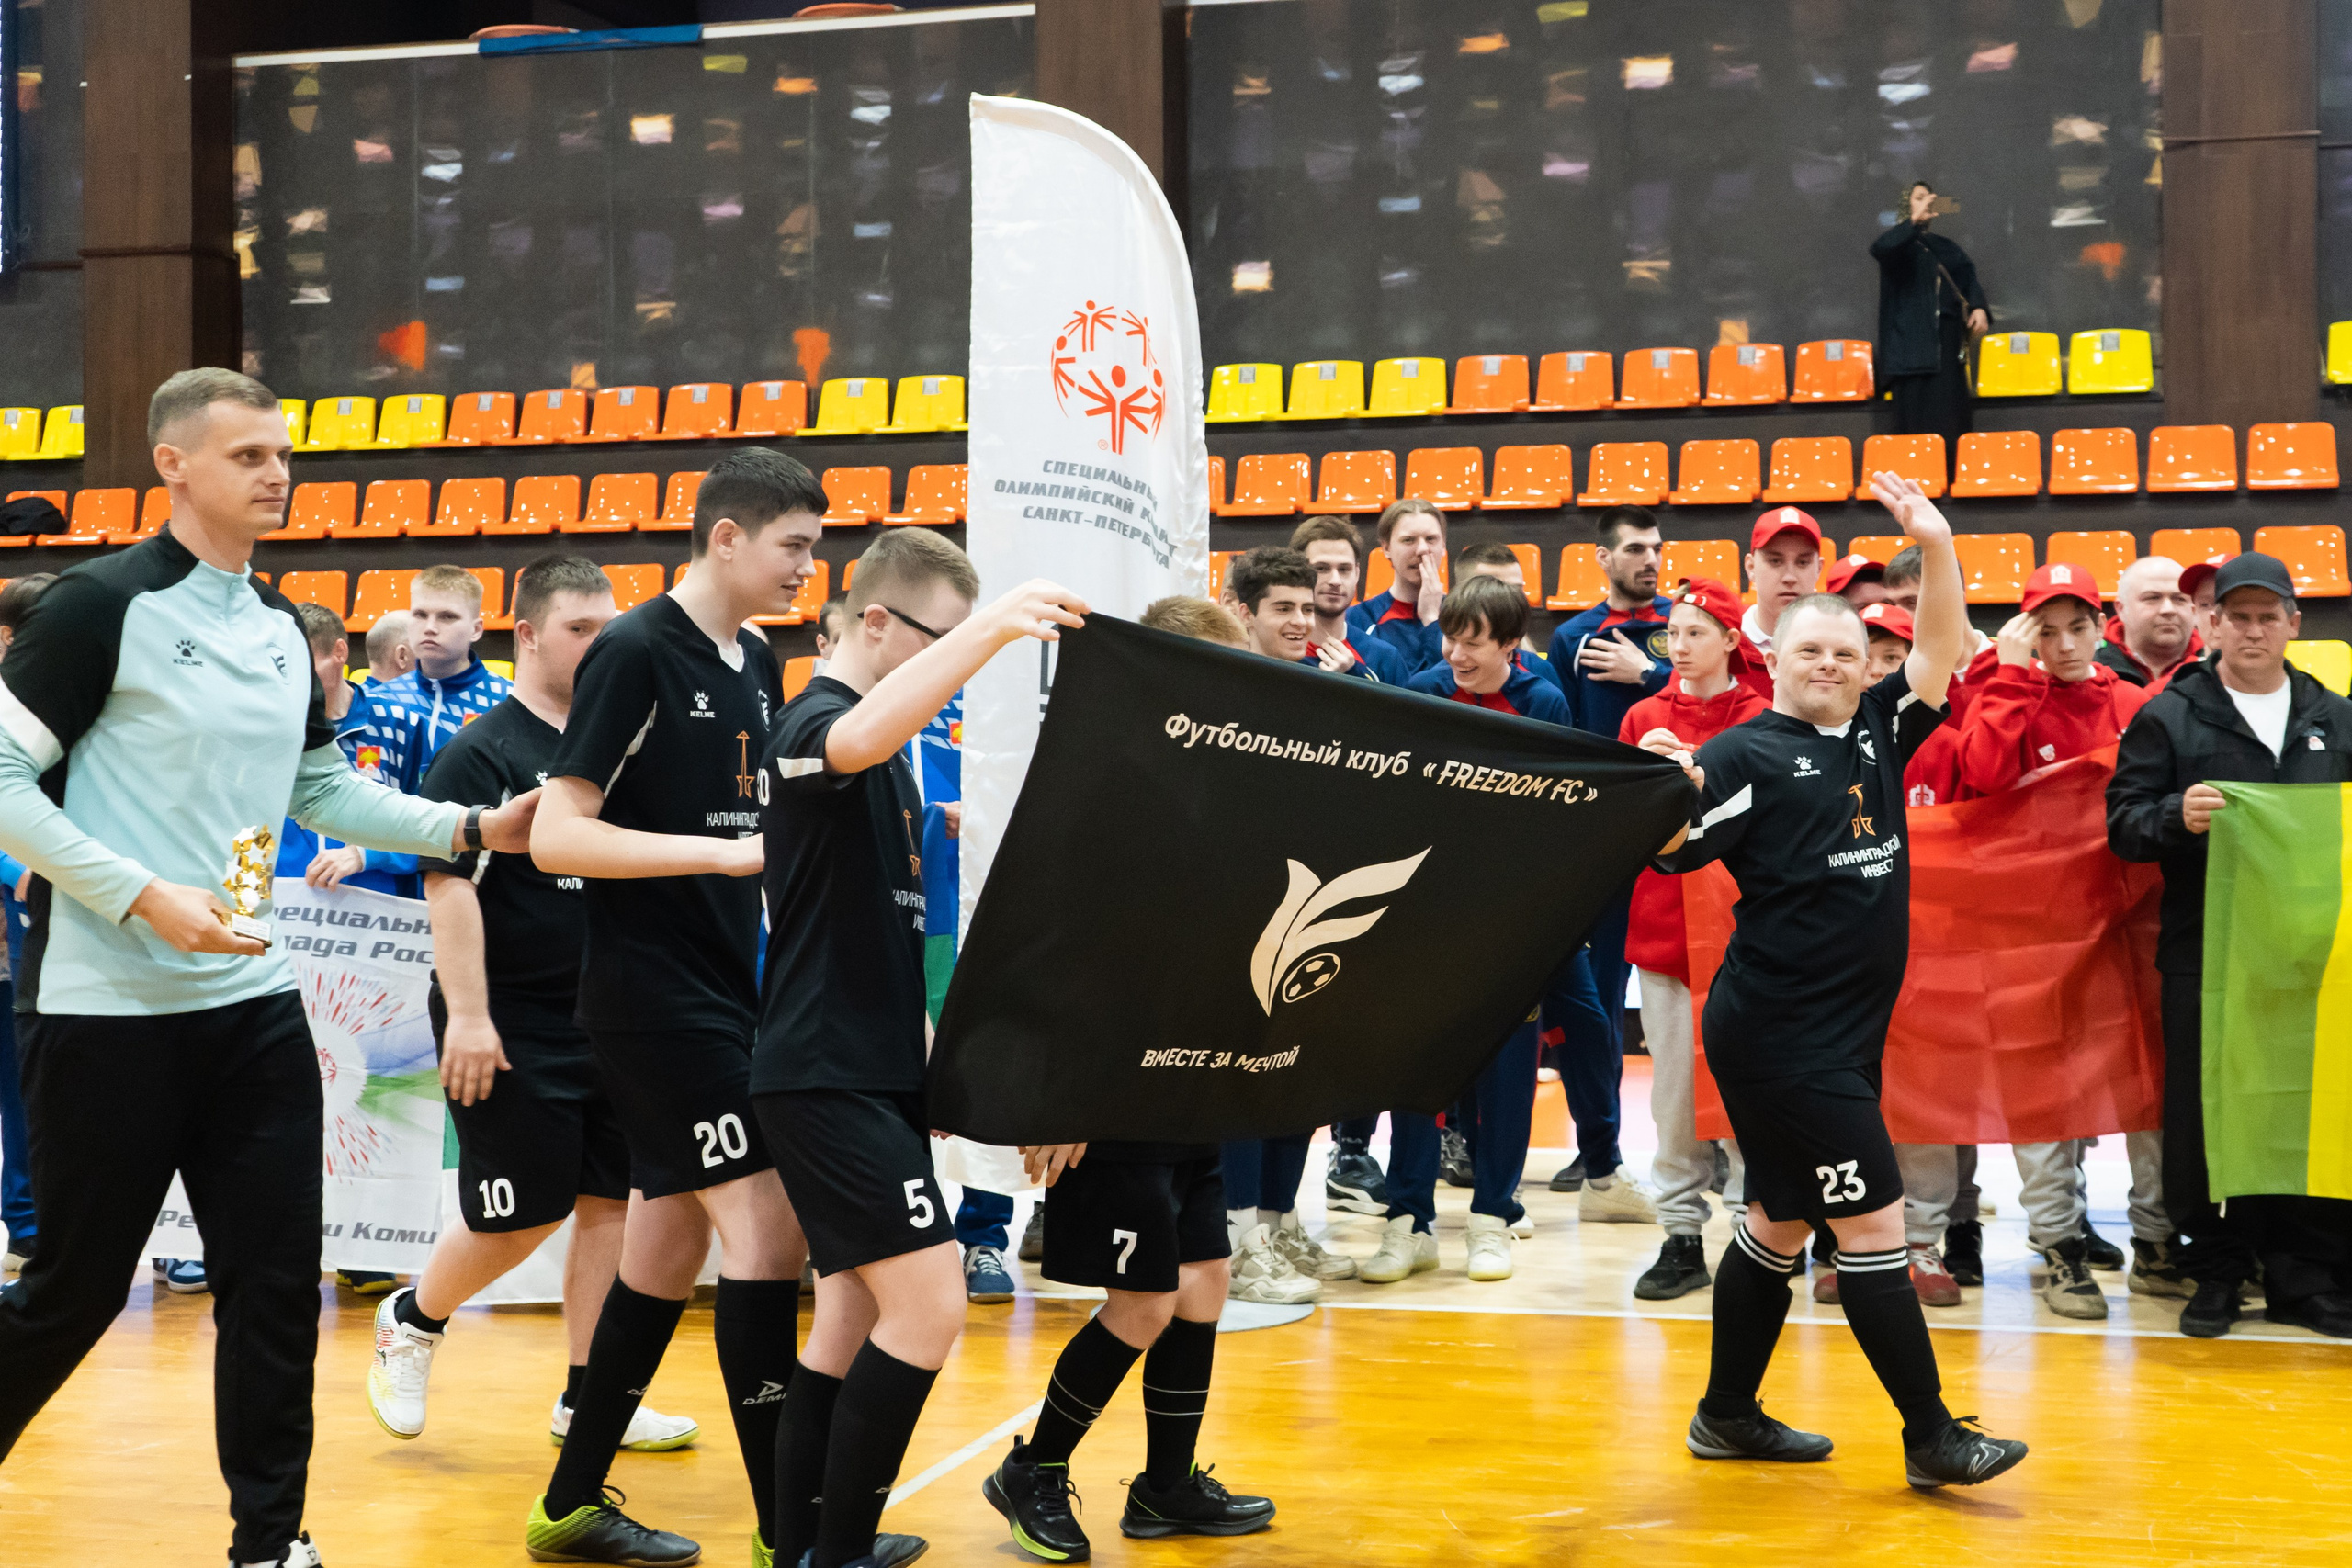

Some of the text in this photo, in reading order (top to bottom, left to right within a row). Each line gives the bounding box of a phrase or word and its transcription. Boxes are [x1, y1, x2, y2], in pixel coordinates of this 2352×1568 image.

[994, 479, 1135, 515] ОЛИМПИЙСКИЙ
[1165, 713, 1341, 766] Футбольный
[1345, 750, 1411, 779] клуб
[1793, 769, 1822, 777] KELME
[1141, 1045, 1300, 1073] ВМЕСТЕ ЗА МЕЧТОЙ
[694, 1113, 748, 1168] 20
[479, 1178, 515, 1219] 10
[903, 1178, 935, 1229] 5
[1816, 1159, 1866, 1204] 23
[1113, 1228, 1138, 1275] 7
